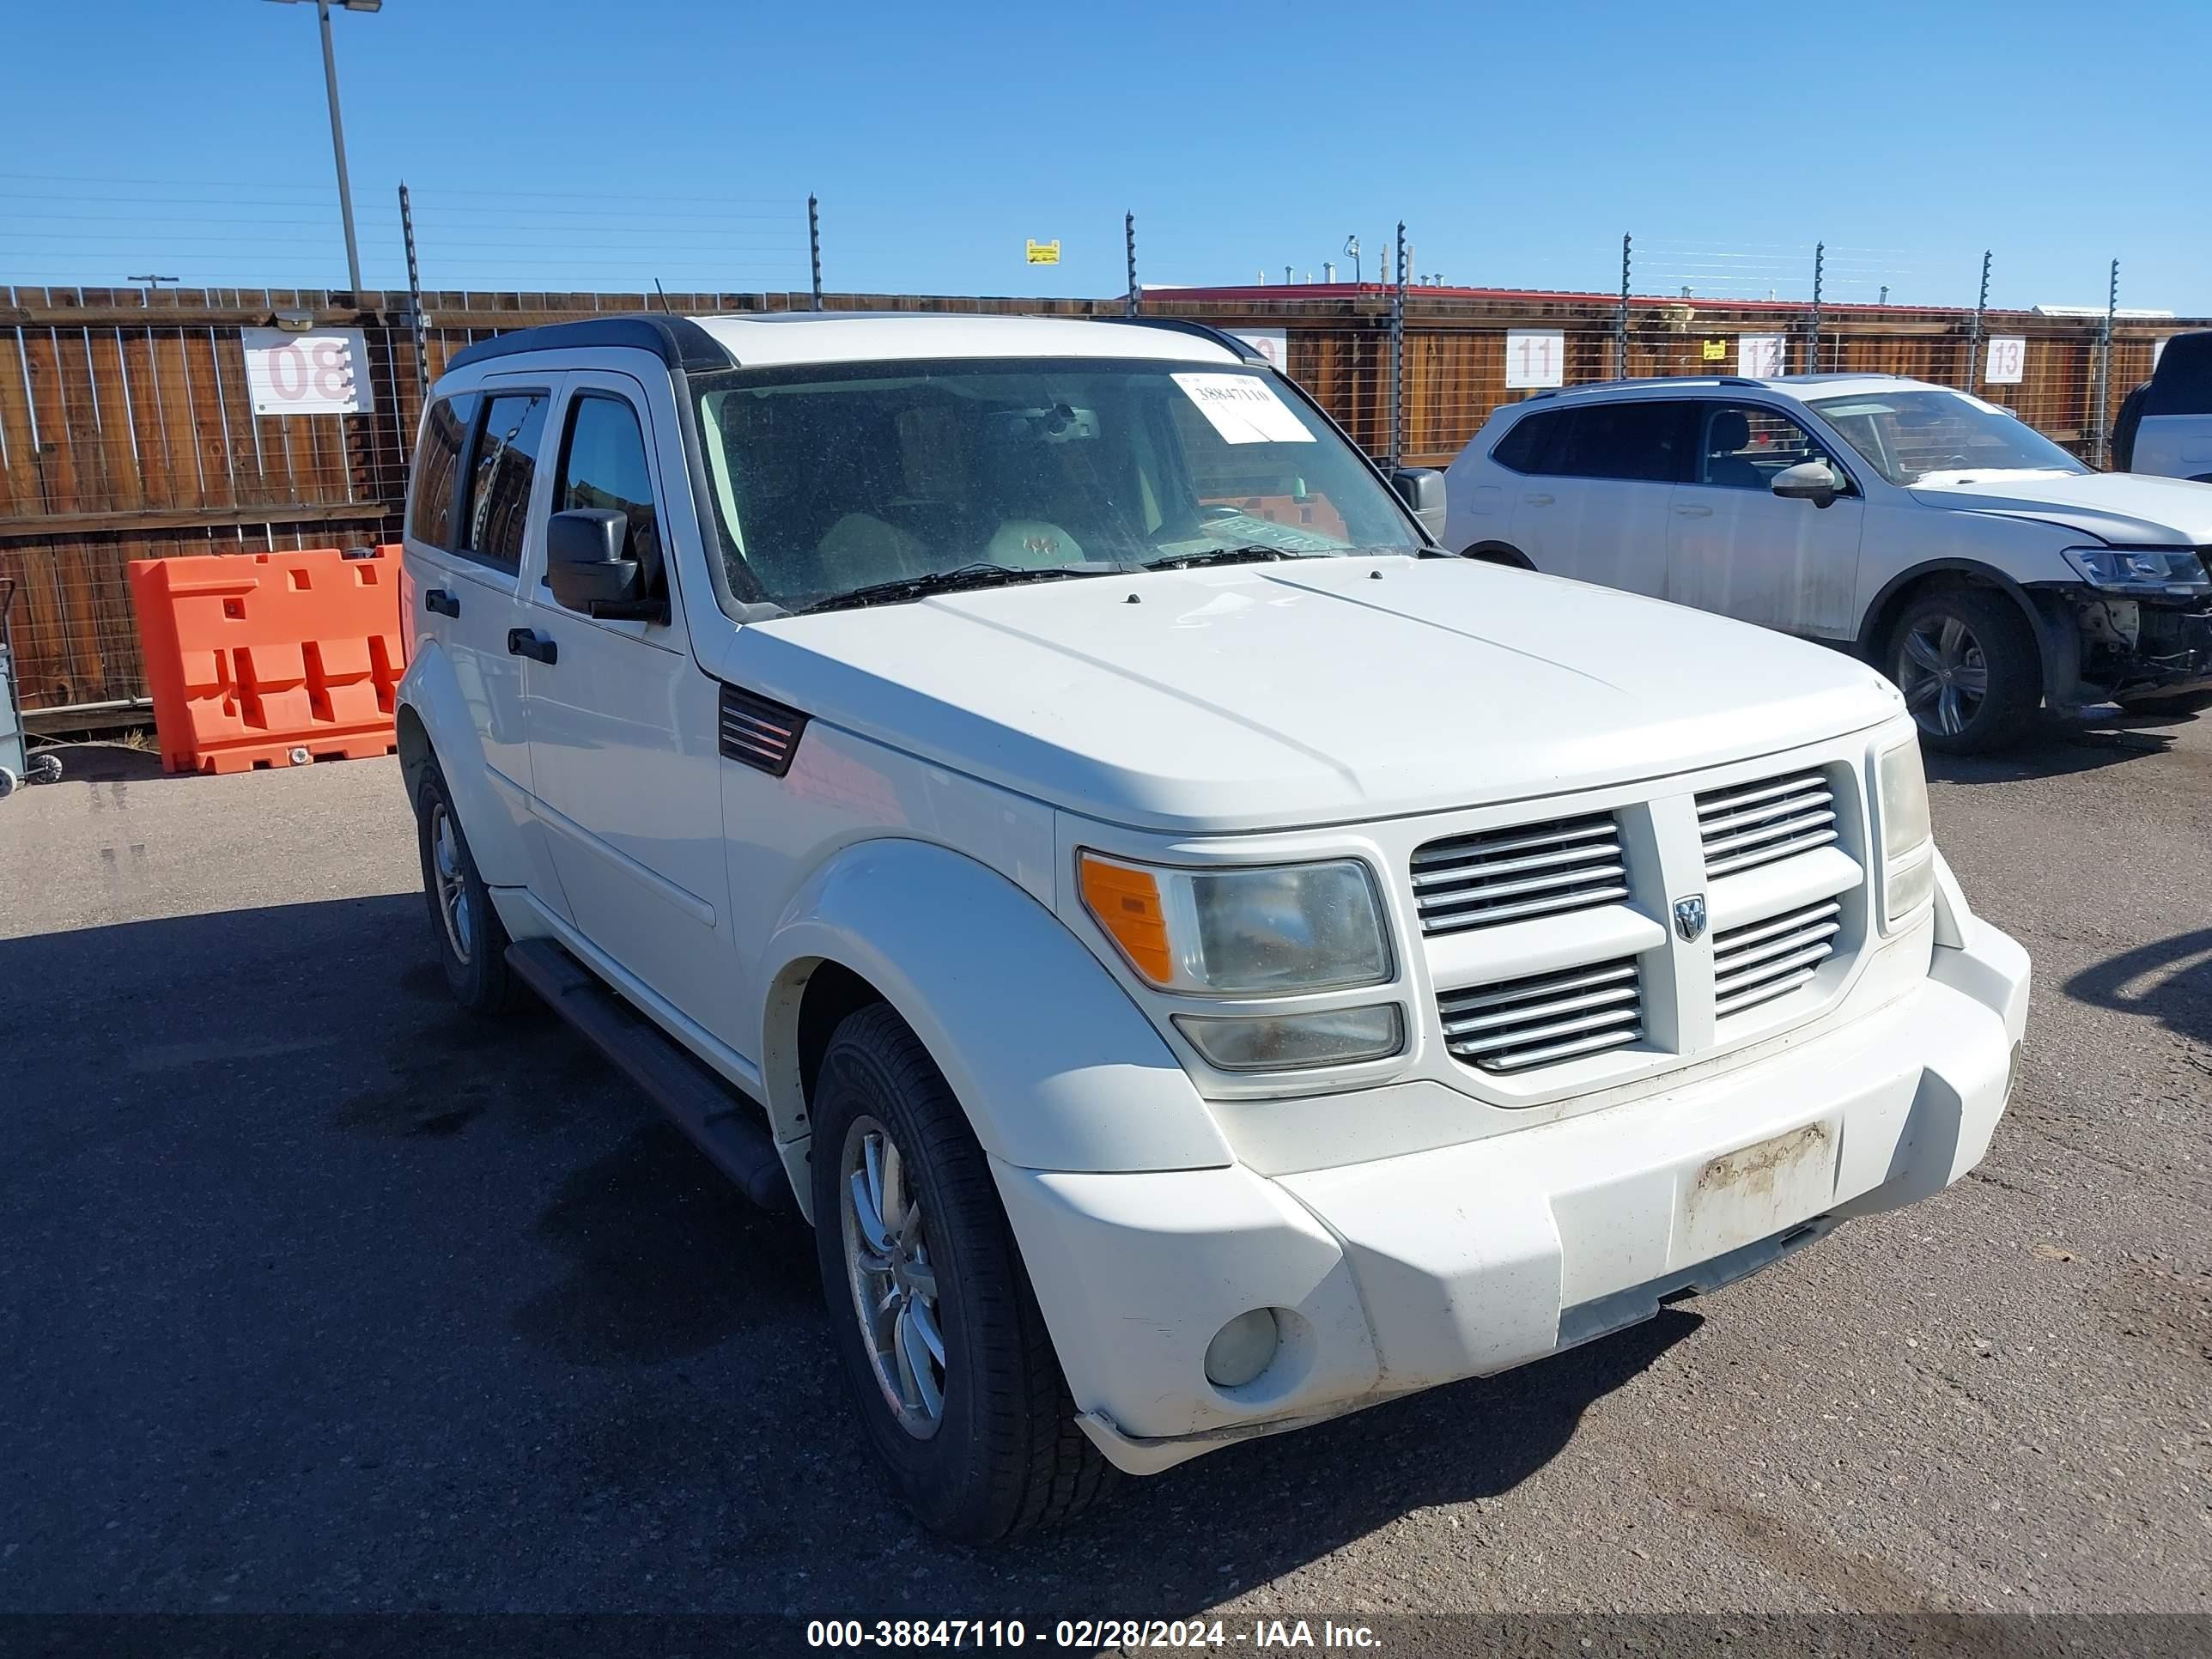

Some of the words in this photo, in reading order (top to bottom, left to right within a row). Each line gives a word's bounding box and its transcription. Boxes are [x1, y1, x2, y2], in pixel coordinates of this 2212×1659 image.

[269, 342, 351, 400] 08
[1518, 338, 1551, 378] 11
[1996, 342, 2019, 374] 13
[1195, 387, 1270, 402] 38847110
